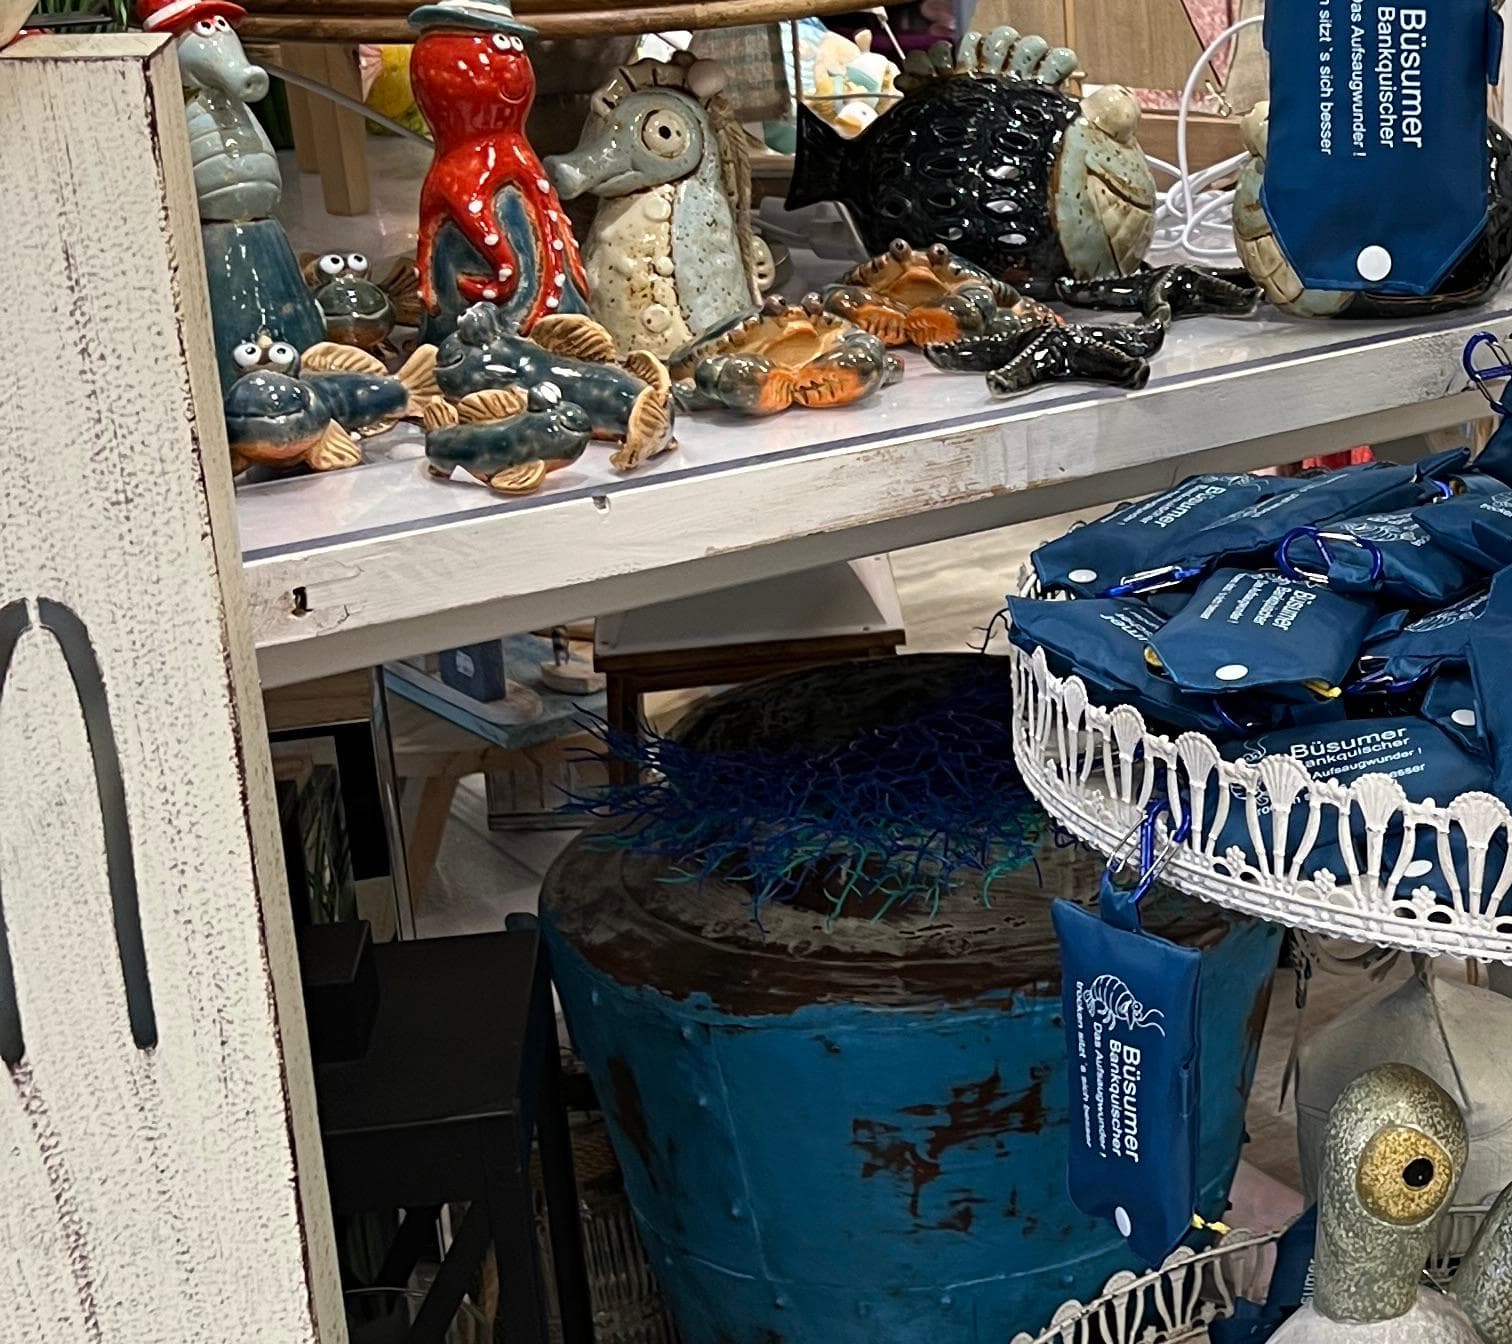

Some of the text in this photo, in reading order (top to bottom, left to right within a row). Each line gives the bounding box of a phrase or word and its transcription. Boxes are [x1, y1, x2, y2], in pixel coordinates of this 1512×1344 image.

[1319, 10, 1332, 43] sitzt
[1319, 64, 1333, 99] sich
[1348, 25, 1365, 148] Aufsaugwunder
[1375, 5, 1396, 148] Bankquischer
[1400, 8, 1426, 148] Büsumer
[1319, 102, 1333, 155] besser
[1272, 589, 1317, 631] Büsumer
[1290, 727, 1408, 758] Büsumer
[1302, 737, 1411, 768] ankquischer
[1312, 749, 1415, 780] Aufsaugwunder
[1093, 1021, 1103, 1048] Das
[1109, 1038, 1122, 1158] Bankquischer
[1122, 1044, 1141, 1163] Büsumer
